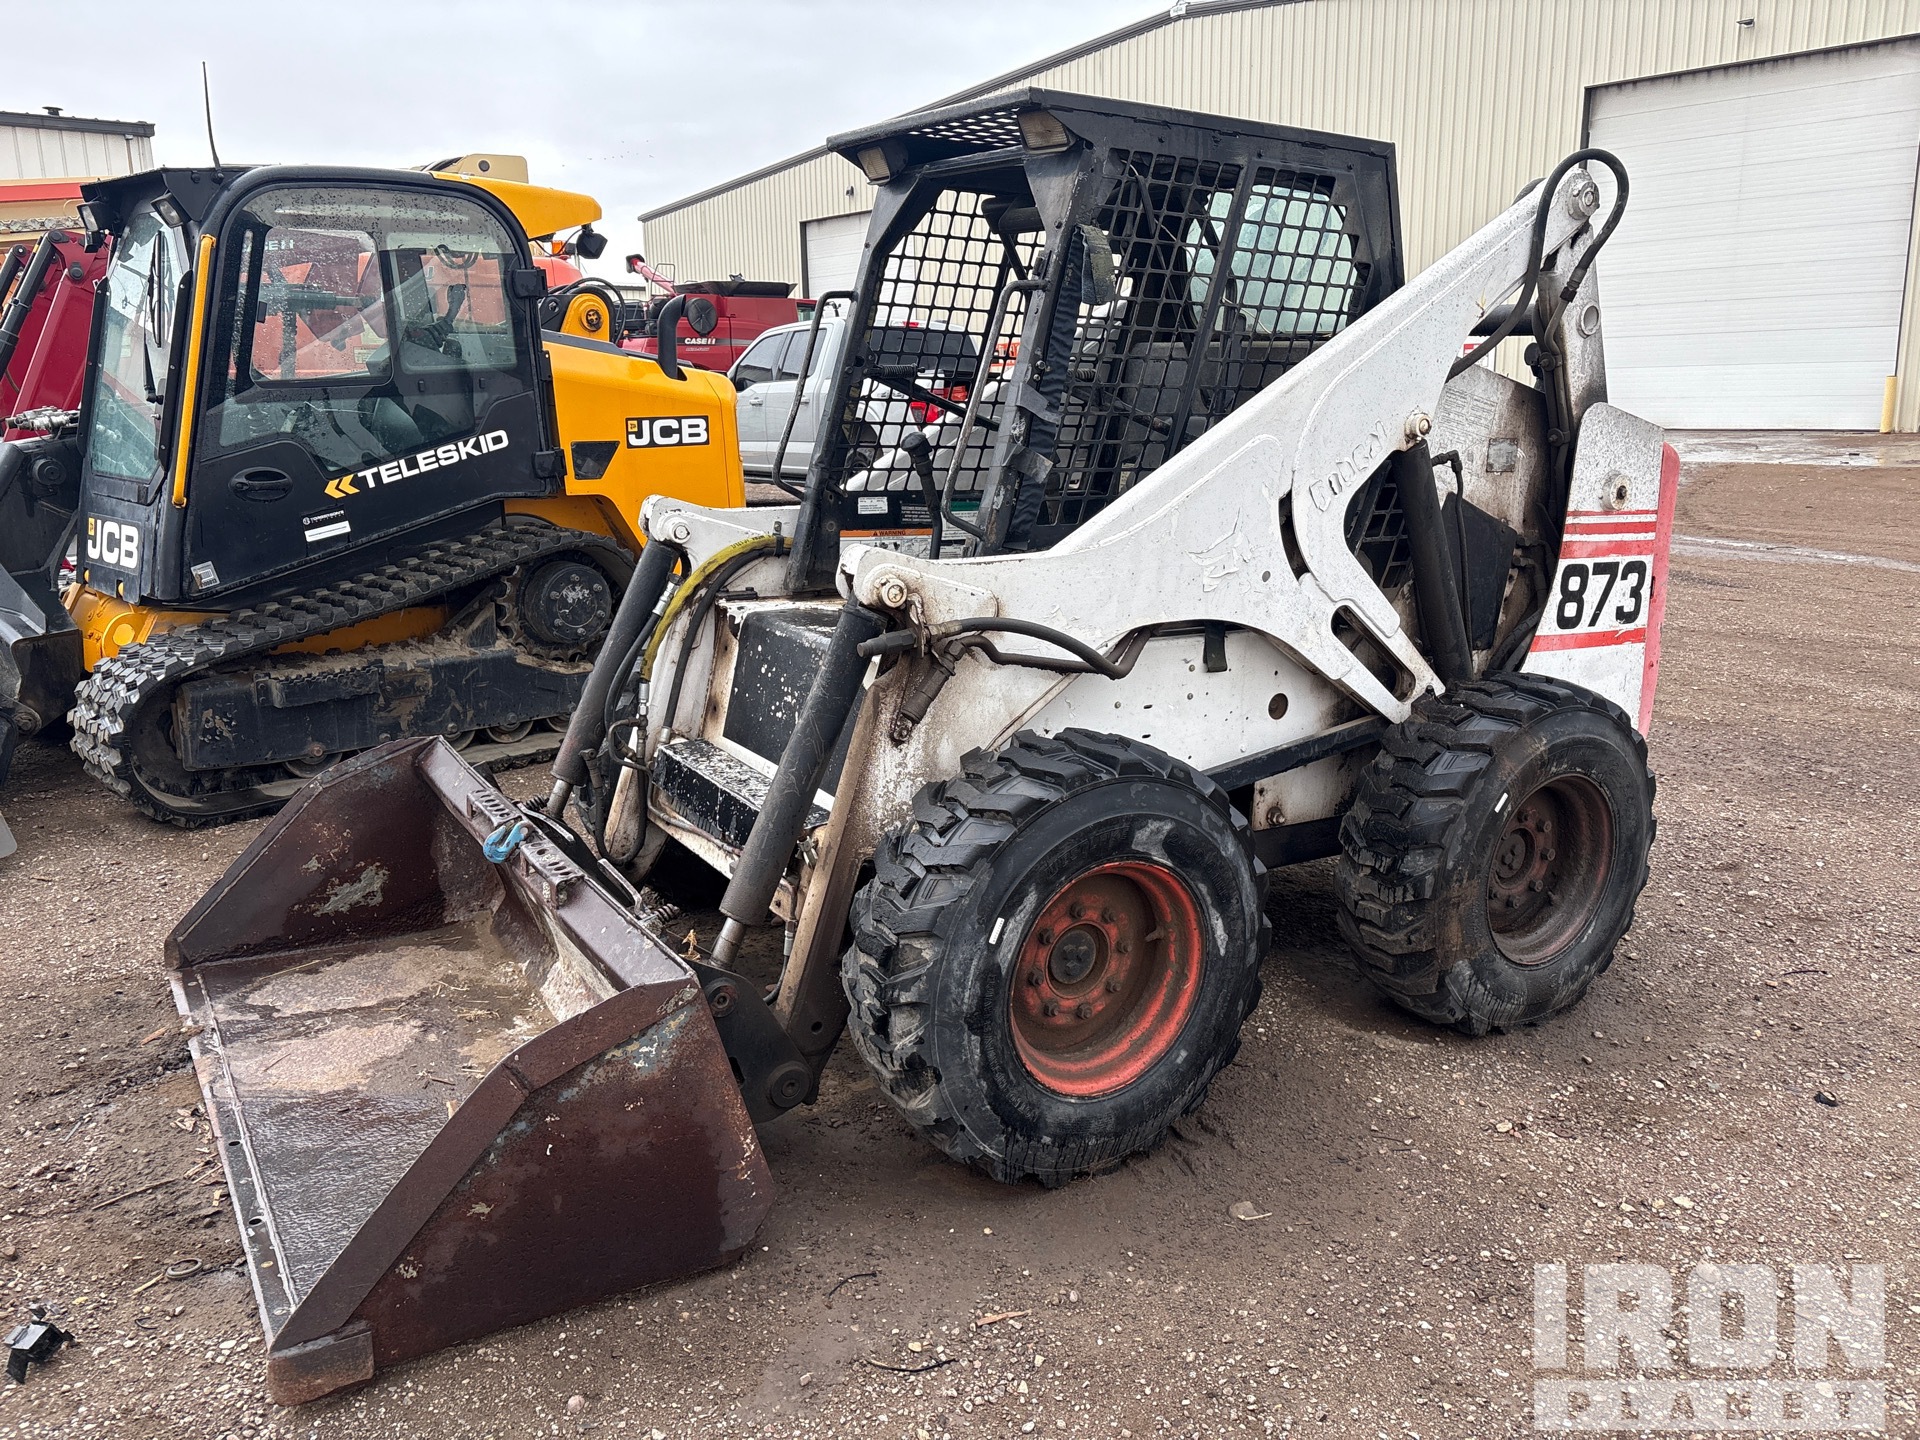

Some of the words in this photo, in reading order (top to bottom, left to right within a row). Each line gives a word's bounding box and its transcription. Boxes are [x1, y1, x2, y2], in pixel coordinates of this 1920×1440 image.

[684, 337, 707, 345] CASE
[627, 418, 708, 446] JCB
[357, 429, 509, 489] TELESKID
[87, 519, 139, 569] JCB
[1556, 560, 1647, 630] 873
